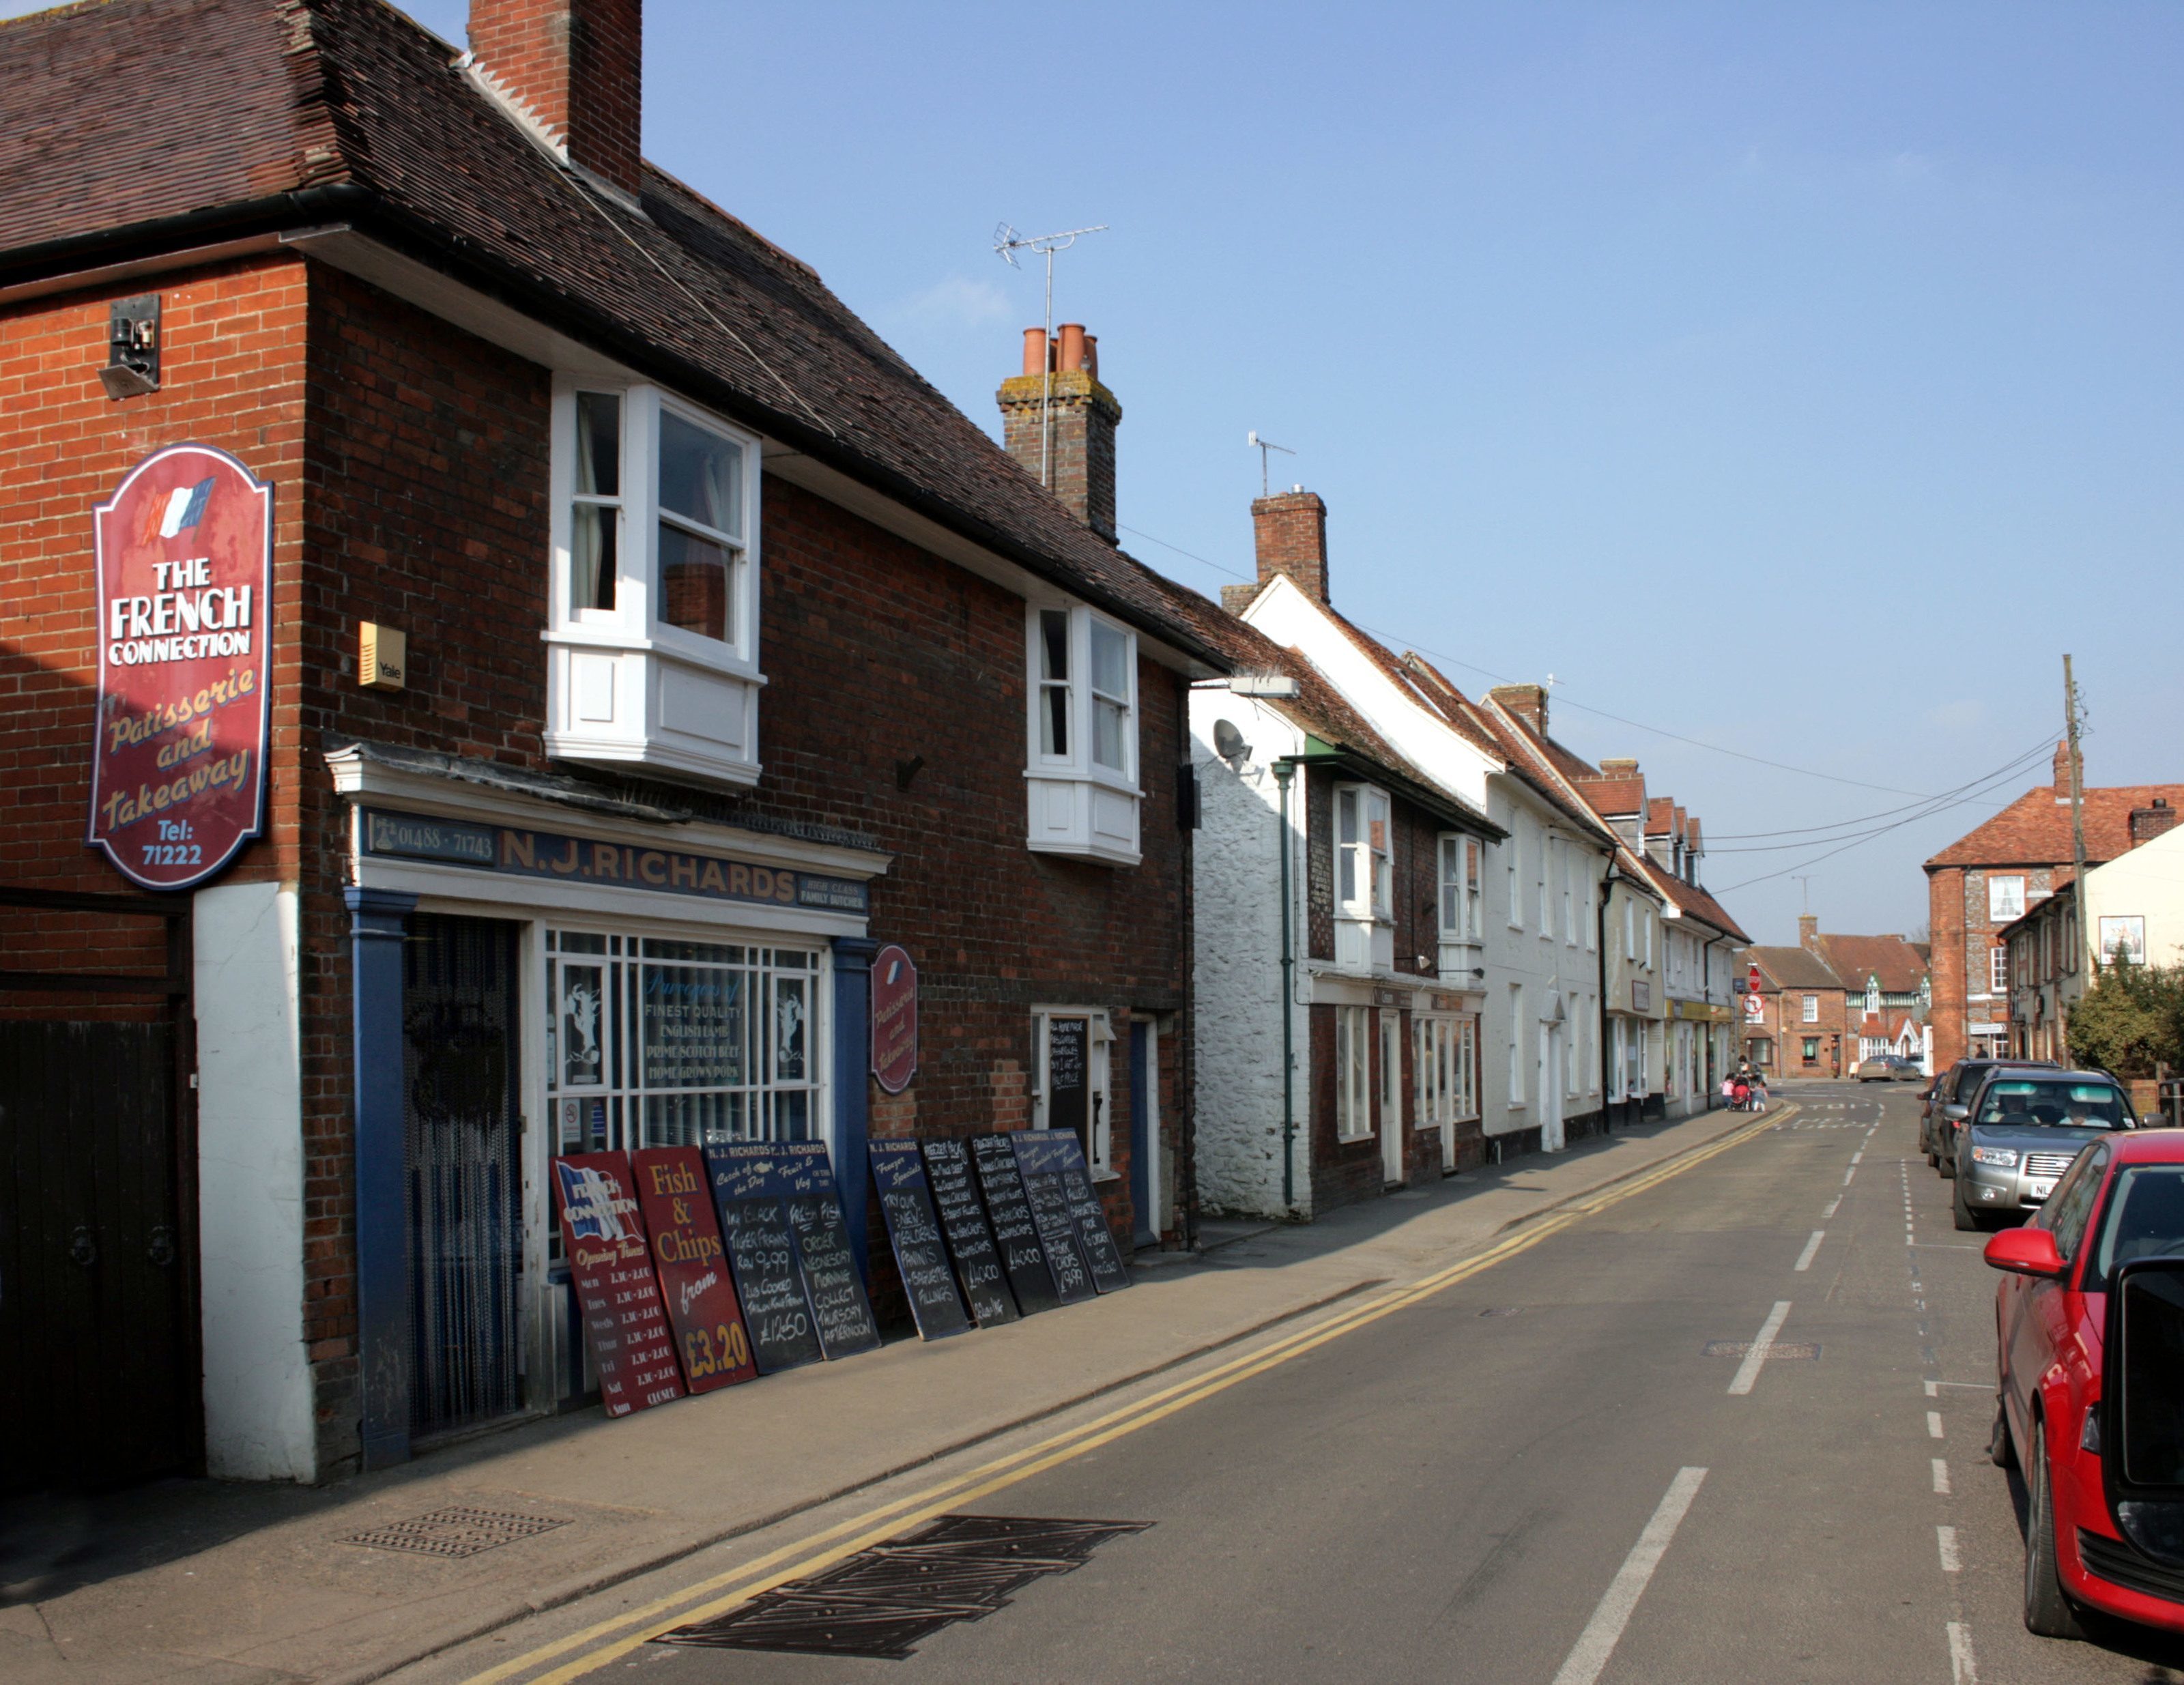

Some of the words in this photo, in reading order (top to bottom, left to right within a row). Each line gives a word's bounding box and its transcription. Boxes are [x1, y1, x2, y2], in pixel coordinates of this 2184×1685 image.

[152, 558, 212, 591] THE
[111, 584, 253, 641] FRENCH
[108, 629, 252, 667] CONNECTION
[379, 661, 401, 679] Yale
[109, 667, 255, 754] Patisserie
[157, 719, 212, 774] and
[102, 748, 249, 833] Takeaway
[158, 819, 193, 841] Tel:
[398, 826, 441, 849] 01488
[453, 833, 493, 859] 71743
[141, 844, 202, 867] 71222
[644, 1005, 689, 1018] FINEST
[693, 1006, 743, 1020] QUALITY
[875, 985, 915, 1029] Patisserie
[660, 1024, 702, 1038] ENGLISH
[703, 1025, 729, 1038] LAMB
[646, 1045, 678, 1058] PRIME
[680, 1045, 717, 1058] SCOTCH
[719, 1045, 741, 1058] BEEF
[649, 1066, 678, 1079] HOME
[713, 1066, 739, 1078] PORK
[885, 1141, 918, 1152] RICHARDS
[1054, 1130, 1077, 1140] RICHARDS
[729, 1145, 771, 1158] RICHARDS
[789, 1144, 827, 1155] RICHARDS
[648, 1161, 698, 1196] Fish
[747, 1175, 765, 1188] Day
[778, 1162, 803, 1179] Fruit
[795, 1176, 811, 1192] Veg
[672, 1196, 693, 1225] &
[657, 1228, 721, 1267] Chips
[802, 1231, 836, 1253] ORDER
[575, 1247, 617, 1271] Opening
[801, 1248, 852, 1272] WEDNESDAY
[680, 1271, 717, 1315] from
[814, 1285, 854, 1309] COLLECT
[918, 1286, 953, 1306] FILLINGS
[818, 1304, 862, 1327] THURSDAY
[824, 1315, 871, 1345] AFTERNOON
[686, 1321, 747, 1379] £3.20
